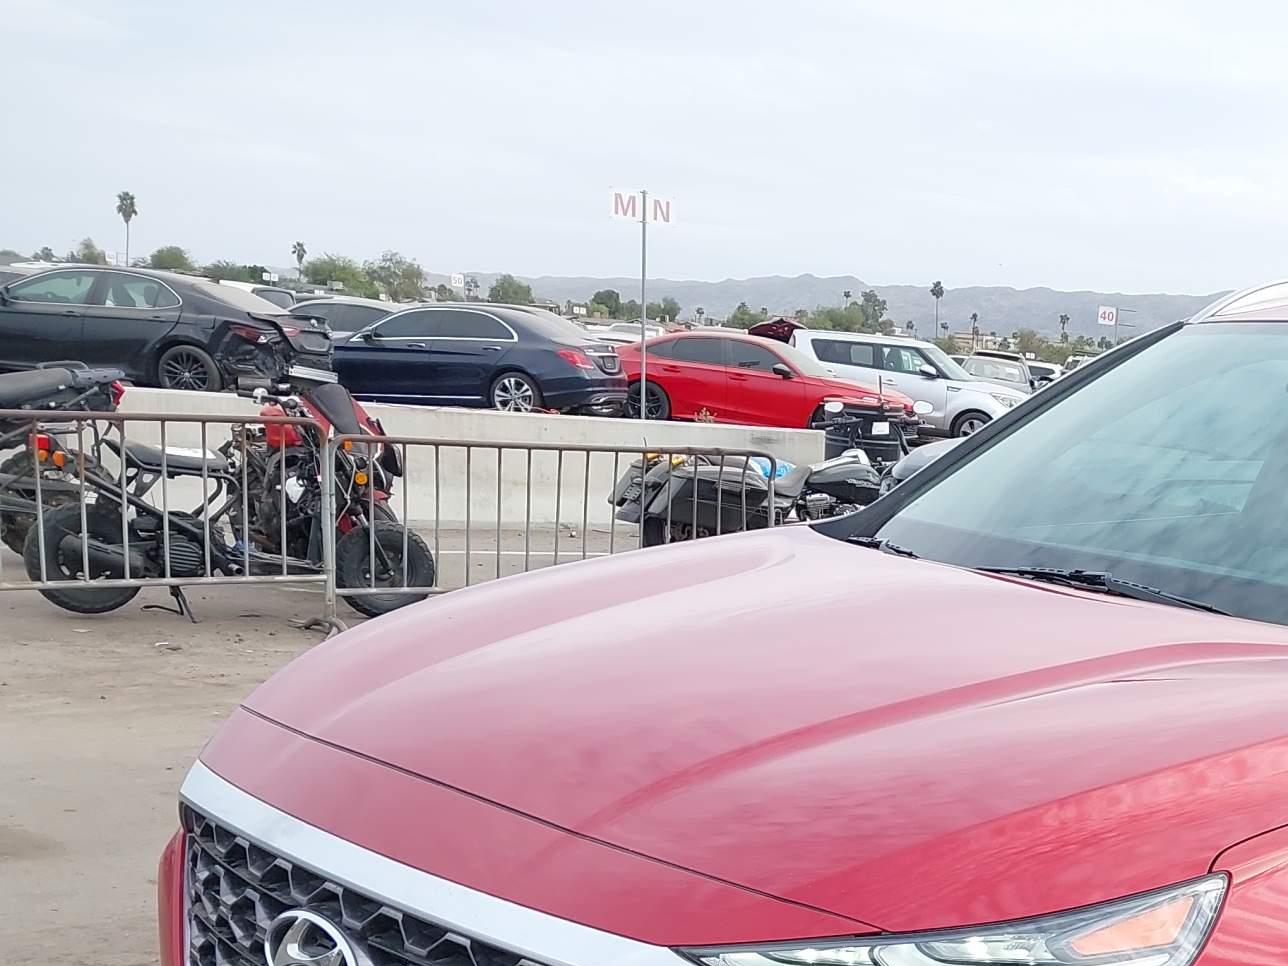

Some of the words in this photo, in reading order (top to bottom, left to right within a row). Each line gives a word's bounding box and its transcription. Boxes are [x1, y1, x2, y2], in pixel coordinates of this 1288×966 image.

[614, 192, 636, 217] M
[653, 199, 670, 223] N
[1099, 310, 1114, 322] 40
